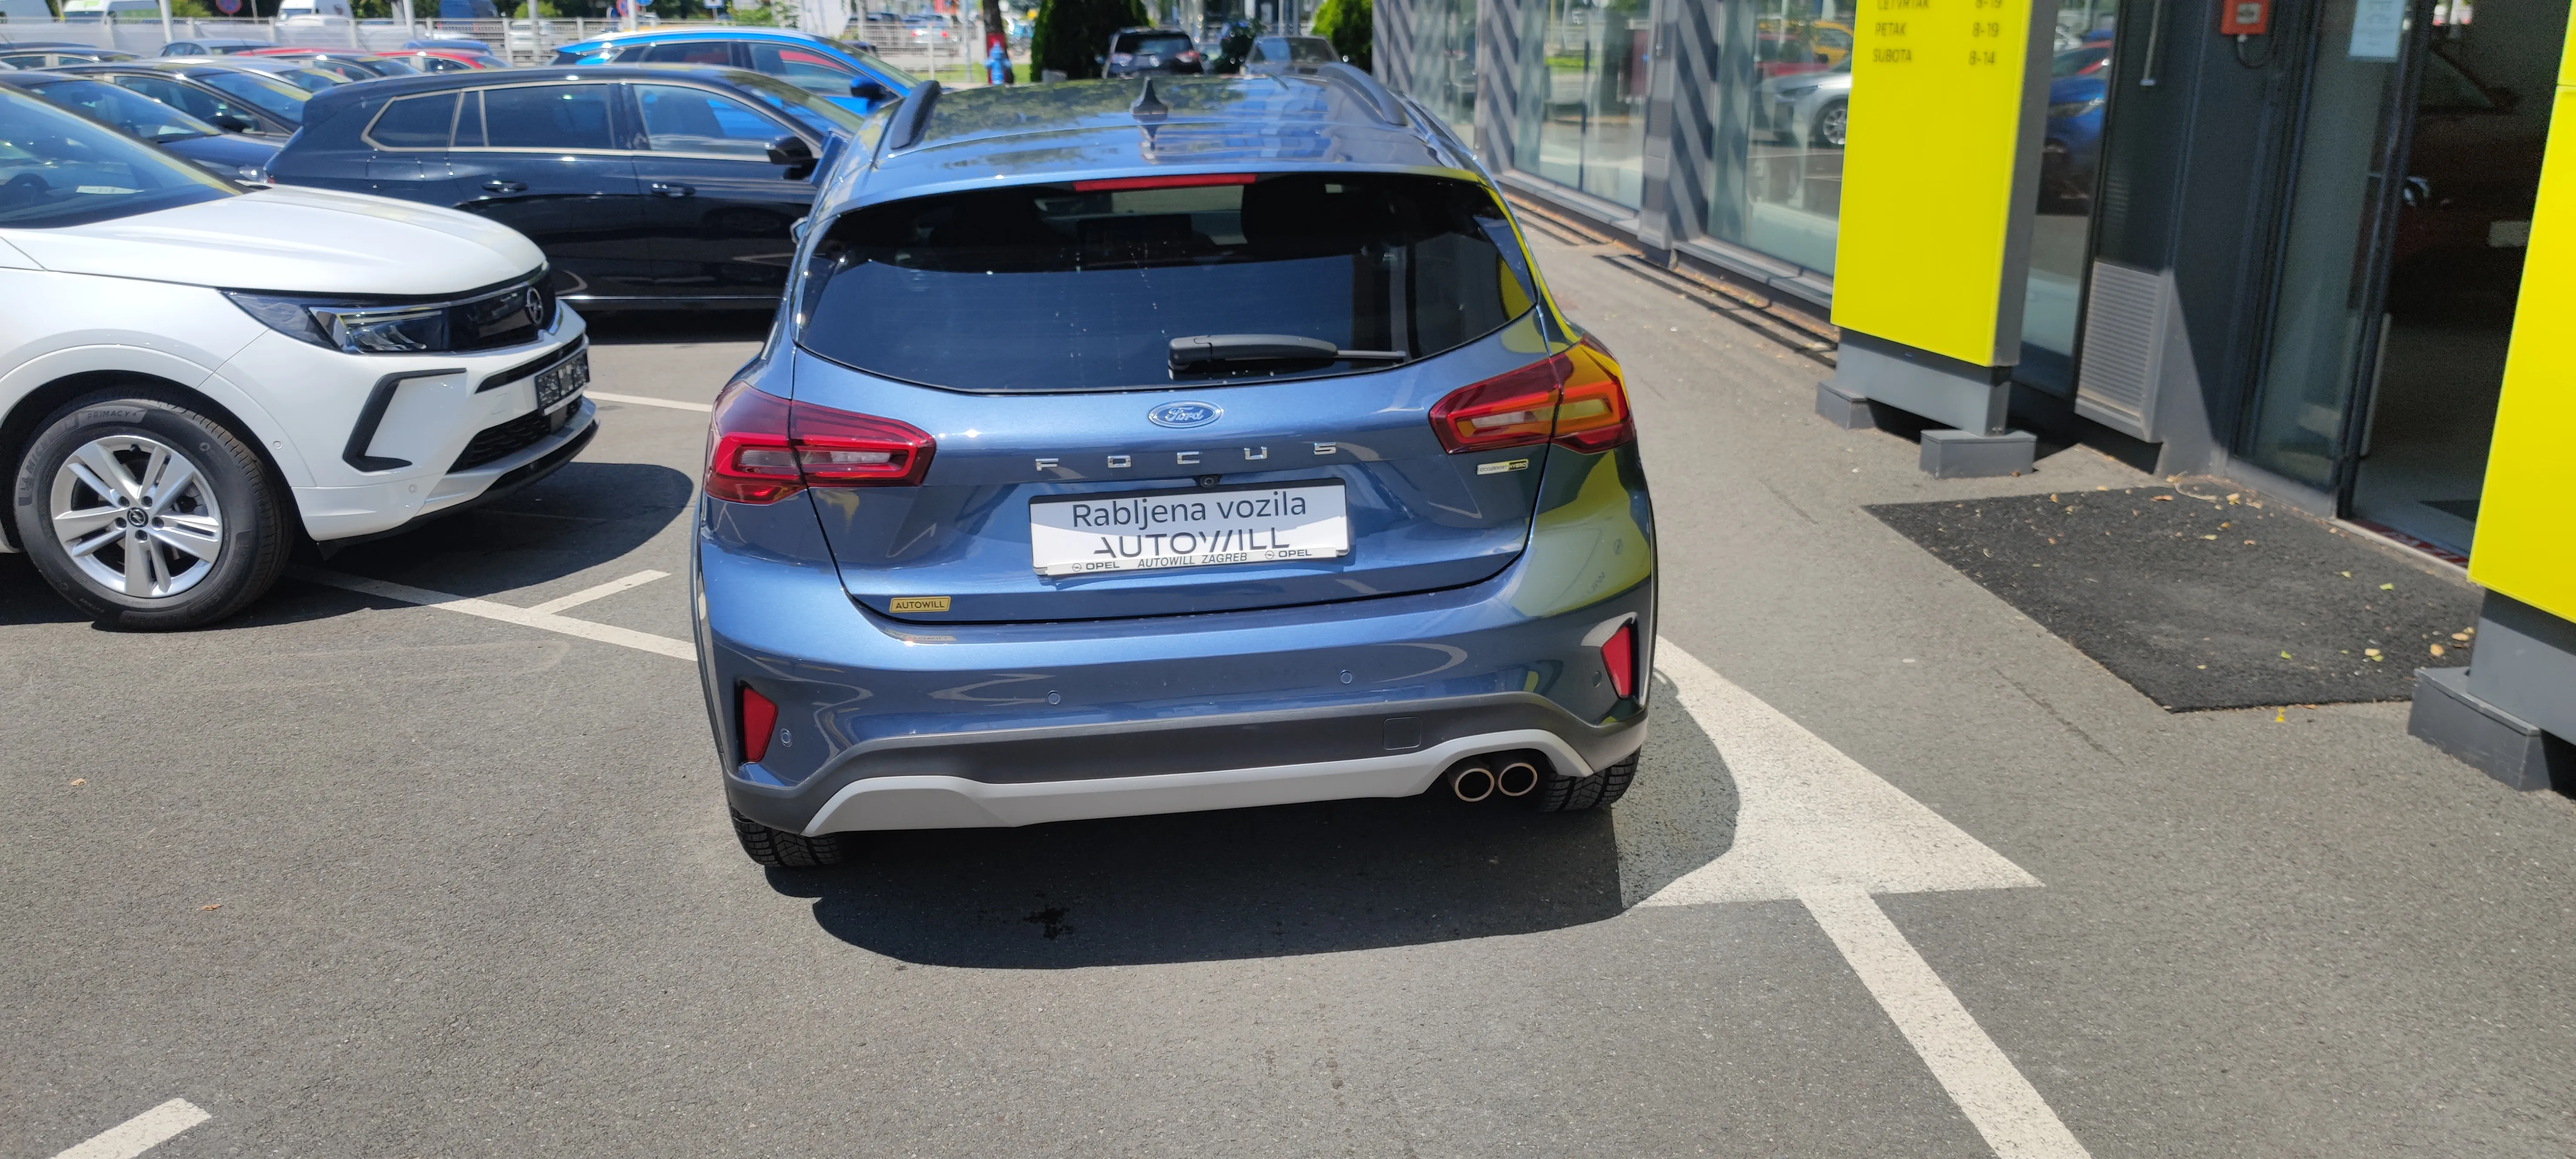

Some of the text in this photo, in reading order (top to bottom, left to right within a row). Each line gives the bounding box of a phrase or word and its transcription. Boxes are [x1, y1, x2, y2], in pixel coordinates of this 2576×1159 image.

[1875, 22, 1999, 37] PETAK 8-19
[1872, 49, 1996, 65] SUBOTA 8-14
[87, 410, 131, 420] PRIMACY
[1165, 406, 1204, 422] Ford
[1035, 442, 1336, 471] FOCUS
[1072, 490, 1306, 530] Rabljena vozila
[1093, 527, 1290, 558] AUTOWILL
[1086, 549, 1312, 570] OPEL AUTOWILL ZAGREB OPEL
[896, 600, 945, 609] AUTOWILL
